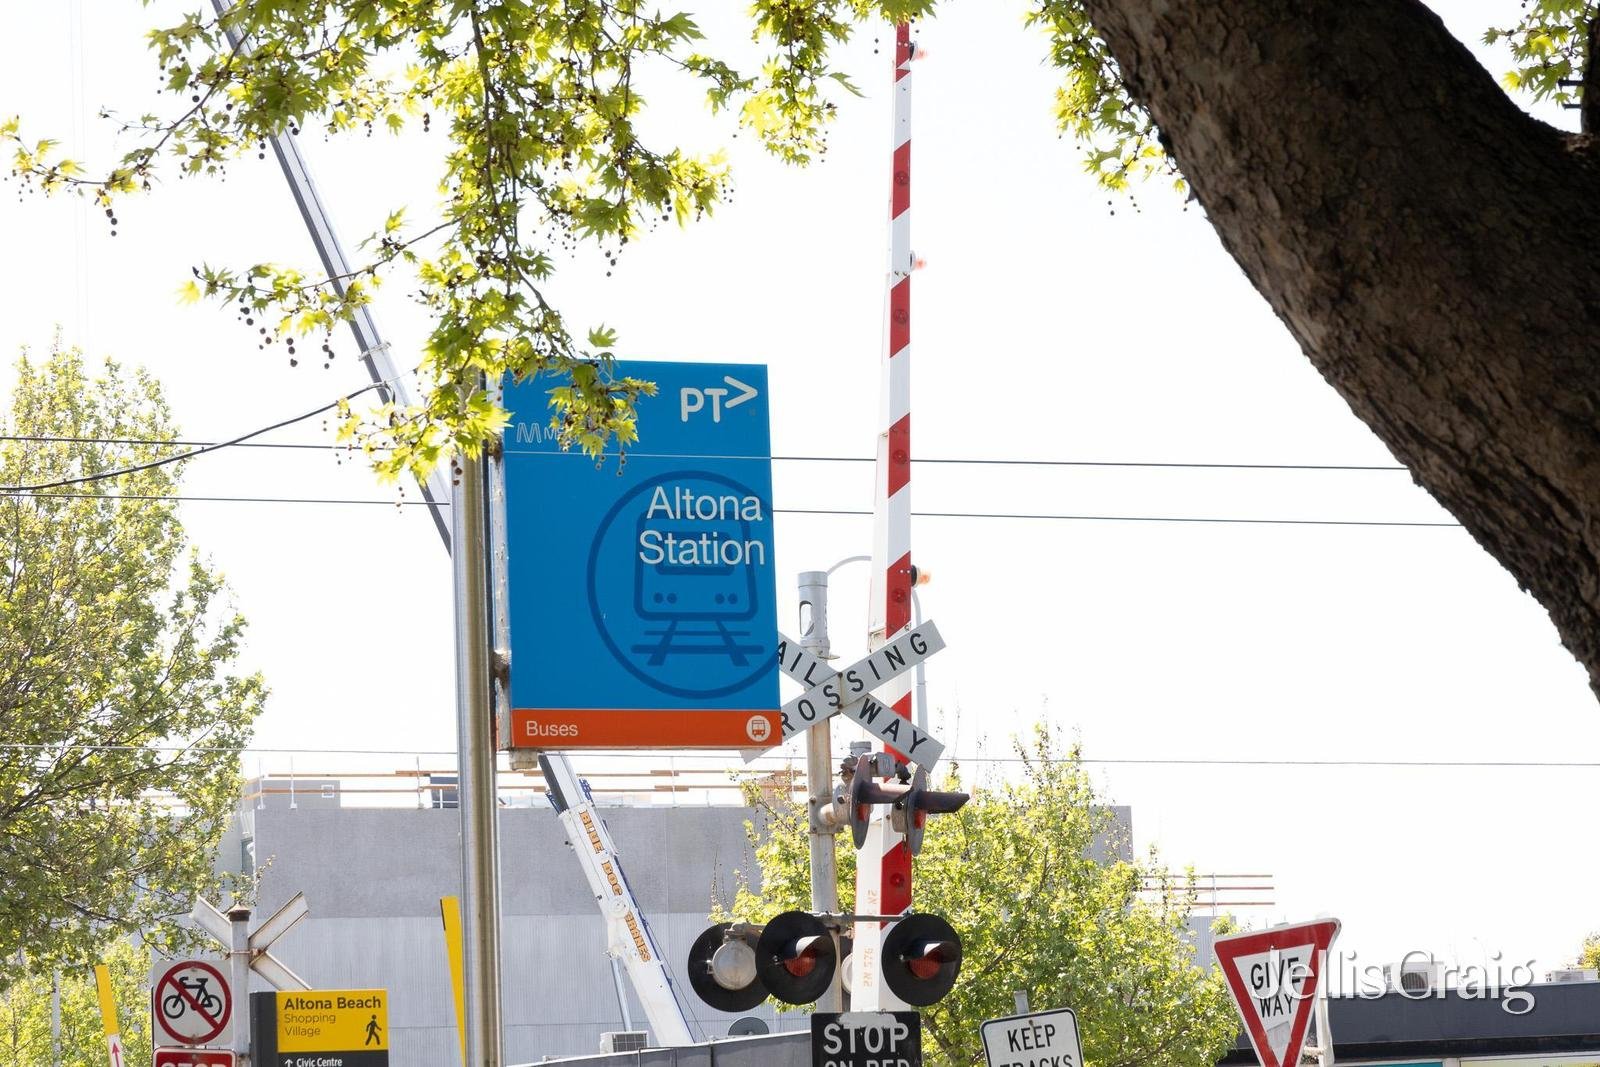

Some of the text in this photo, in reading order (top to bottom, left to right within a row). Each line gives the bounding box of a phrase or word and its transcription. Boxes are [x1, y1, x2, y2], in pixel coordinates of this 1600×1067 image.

[646, 486, 763, 521] Altona
[639, 529, 765, 565] Station
[778, 640, 928, 754] AIL WAY
[780, 632, 928, 737] ROSSING
[526, 720, 578, 737] Buses
[1251, 957, 1299, 990] GIVE
[284, 996, 381, 1010] Altona Beach
[1260, 993, 1293, 1018] WAY
[284, 1014, 336, 1024] Shopping
[285, 1026, 321, 1038] Village
[823, 1022, 909, 1055] STOP
[1007, 1023, 1056, 1053] KEEP
[296, 1058, 343, 1067] Civic Centre
